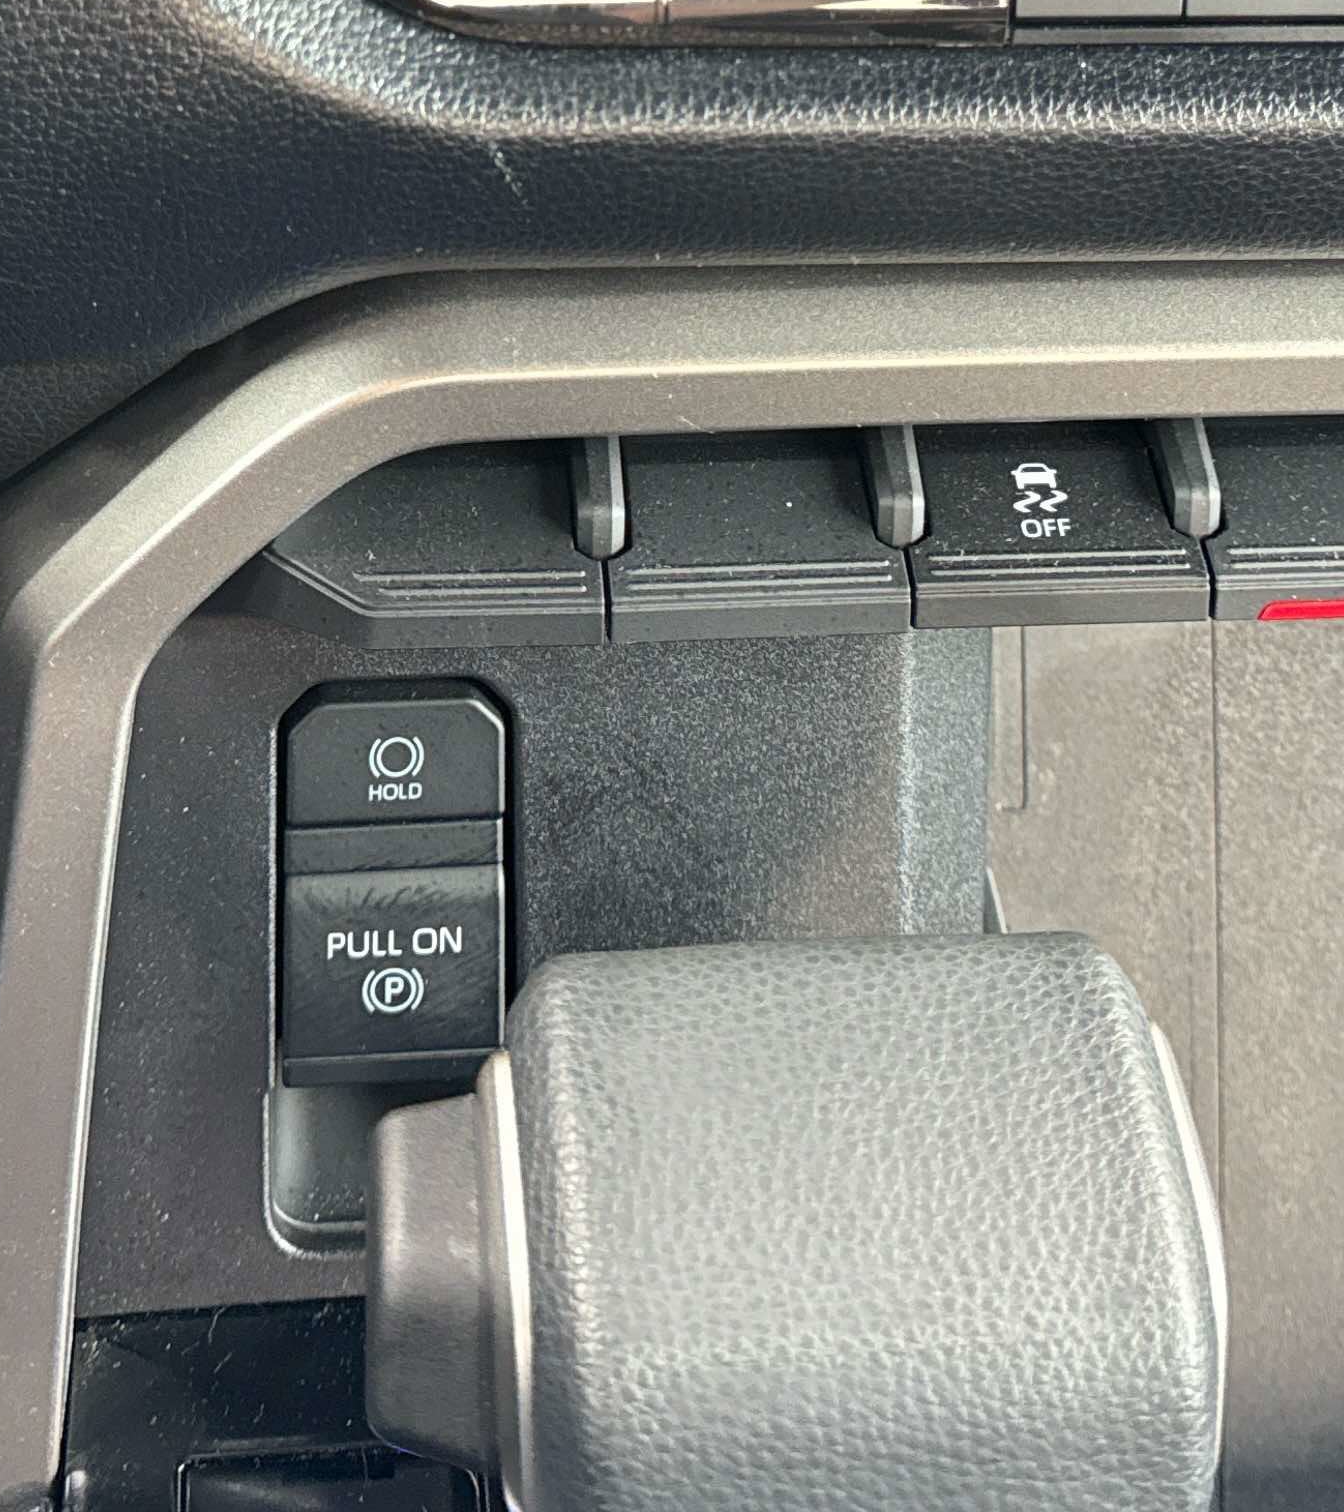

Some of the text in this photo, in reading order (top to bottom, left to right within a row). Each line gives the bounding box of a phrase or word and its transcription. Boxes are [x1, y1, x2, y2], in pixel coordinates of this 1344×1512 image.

[1020, 518, 1072, 538] OFF
[368, 782, 423, 801] HOLD
[327, 926, 463, 960] PULL ON
